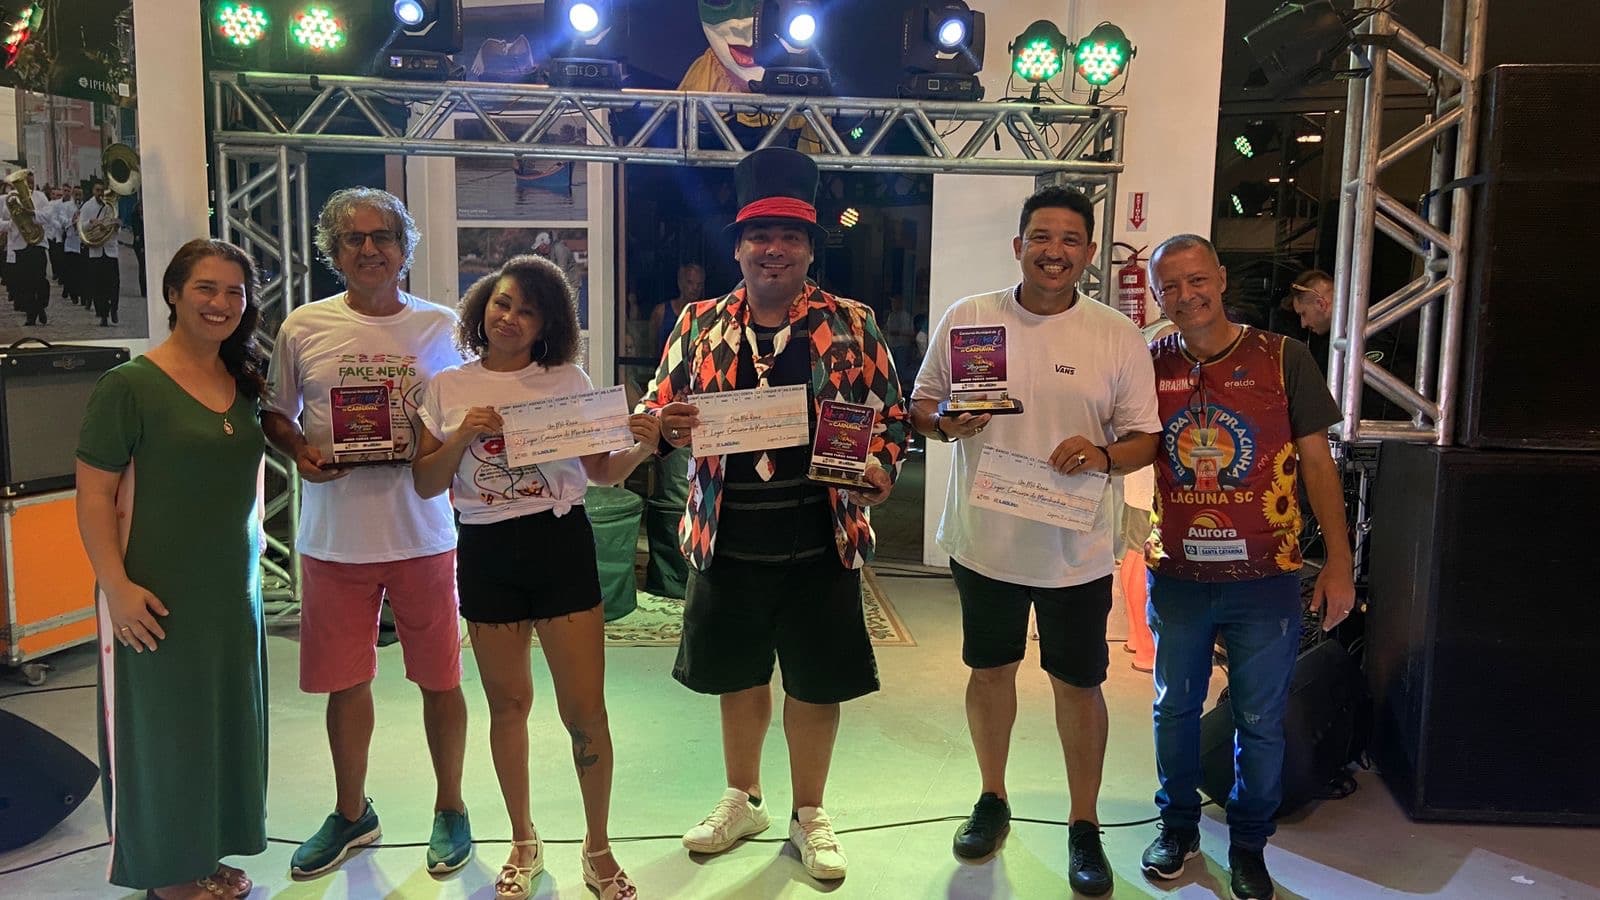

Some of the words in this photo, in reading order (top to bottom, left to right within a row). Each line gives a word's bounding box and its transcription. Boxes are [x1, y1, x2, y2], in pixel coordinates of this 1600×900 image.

[90, 80, 118, 94] IPHAN
[338, 367, 374, 376] FAKE
[378, 367, 416, 377] NEWS
[1055, 364, 1076, 375] VANS
[1224, 379, 1255, 389] eraldo
[1169, 416, 1189, 433] DA
[1218, 412, 1253, 479] PRACINHA
[1170, 492, 1229, 504] LAGUNA
[1234, 491, 1254, 504] SC
[1188, 527, 1237, 538] Aurora
